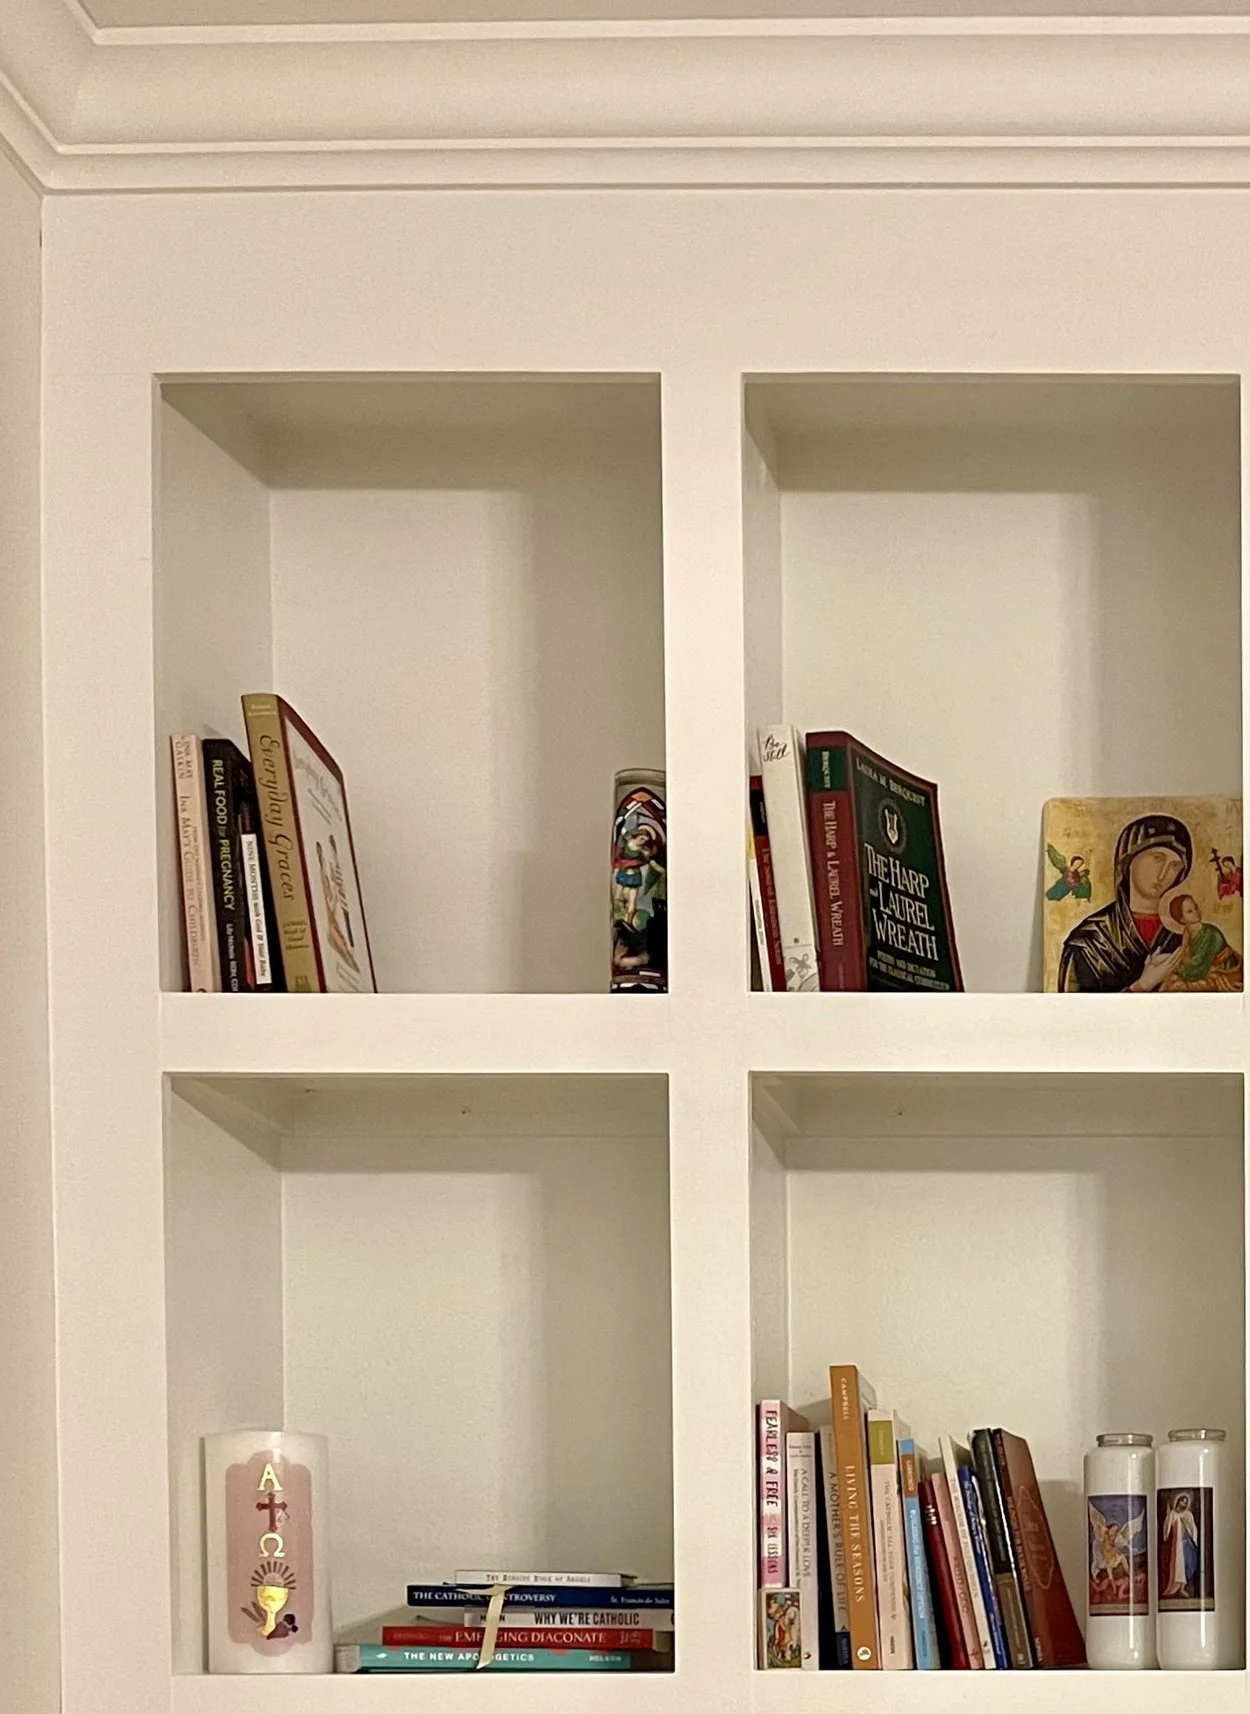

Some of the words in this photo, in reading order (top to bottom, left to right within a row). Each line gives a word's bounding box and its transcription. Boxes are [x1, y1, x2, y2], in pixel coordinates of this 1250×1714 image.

[211, 759, 226, 788] REAL
[257, 733, 290, 829] Everyday
[214, 790, 228, 825] FOOD
[822, 801, 837, 820] THE
[825, 821, 838, 849] HARP
[219, 839, 235, 910] PREGNANCY
[268, 833, 294, 901] Graces
[864, 843, 888, 884] THE
[889, 856, 929, 898] HARP
[878, 880, 935, 931] LAUREL
[830, 901, 844, 946] WREATH
[872, 907, 939, 961] WREATH
[840, 1377, 850, 1420] CAMPBELL
[256, 1463, 283, 1491] A
[844, 1465, 857, 1510] LIVING
[766, 1480, 779, 1507] FREE
[848, 1514, 860, 1539] THE
[259, 1532, 285, 1557] Ω
[850, 1543, 864, 1603] SEASONS
[413, 1591, 433, 1601] THE
[534, 1612, 557, 1625] WHY
[559, 1612, 590, 1625] WE'RE
[592, 1612, 639, 1626] CATHOLIC
[530, 1632, 607, 1644] DIACONATE
[404, 1652, 427, 1661] THE
[429, 1652, 454, 1661] NEW
